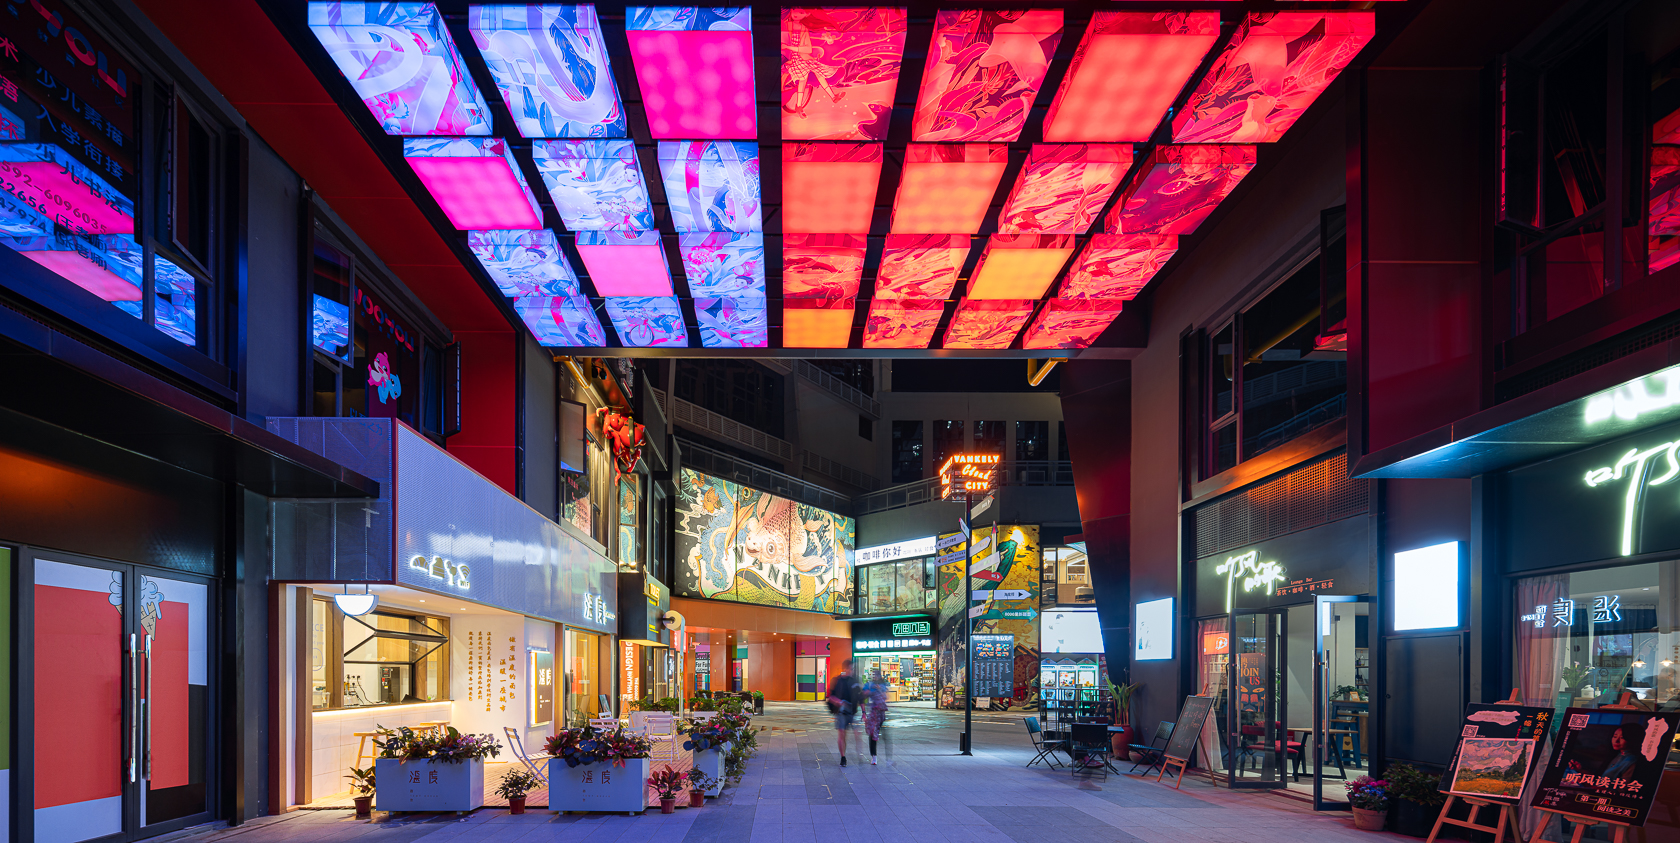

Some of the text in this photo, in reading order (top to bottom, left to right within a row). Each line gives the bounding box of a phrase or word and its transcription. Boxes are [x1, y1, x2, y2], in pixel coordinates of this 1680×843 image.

[12, 0, 127, 98] YOU
[36, 67, 124, 147] 少儿素描
[36, 104, 124, 182] 入学衔接
[35, 143, 124, 216] 少儿书法
[953, 455, 1000, 463] VANKELY
[962, 464, 991, 480] Cloud
[965, 481, 989, 490] CITY
[862, 546, 902, 561] 咖啡你好
[625, 641, 634, 671] DESIGN
[1249, 676, 1260, 686] US
[1565, 772, 1644, 793] 听风读书会
[1580, 794, 1608, 805] 第一期
[1596, 804, 1632, 816] 阅读之美
